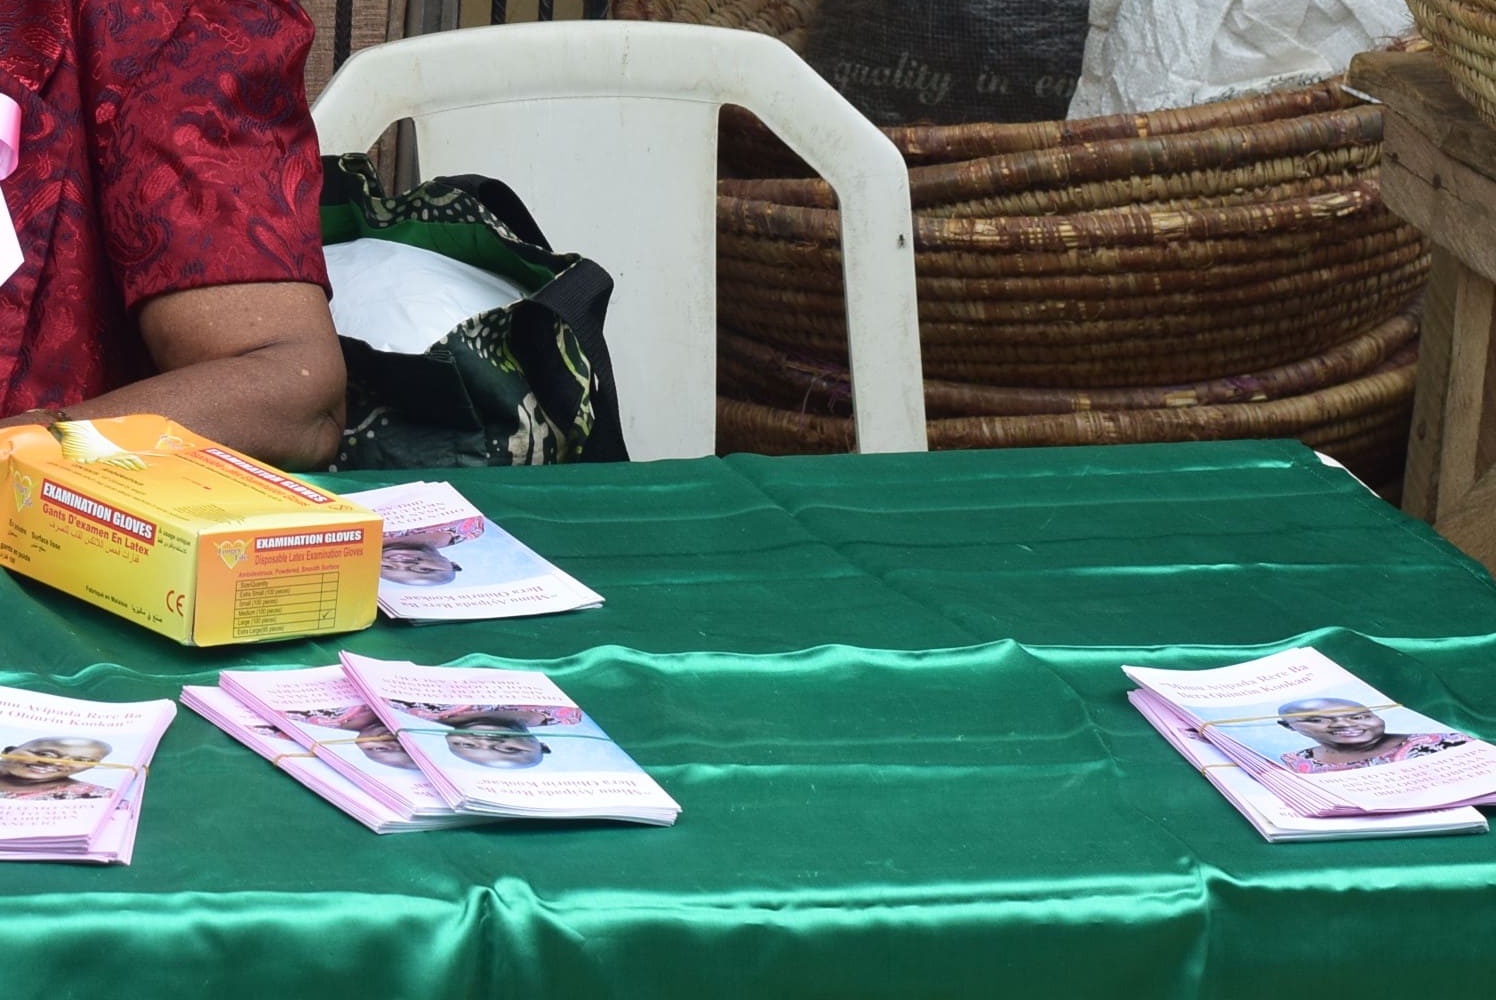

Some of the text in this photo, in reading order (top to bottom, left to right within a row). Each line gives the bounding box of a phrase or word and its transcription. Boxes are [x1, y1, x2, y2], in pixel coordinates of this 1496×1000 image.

[206, 448, 284, 483] EXAMINATION
[280, 480, 328, 503] GLOVES
[42, 503, 66, 522] Gants
[67, 513, 110, 541] D'examen
[111, 533, 122, 546] En
[124, 536, 150, 557] Latex
[43, 482, 111, 523] EXAMINATION
[112, 513, 153, 540] GLOVES
[256, 530, 362, 550] EXAMINATION GLOVES
[306, 548, 342, 561] Examination
[342, 545, 364, 557] Gloves
